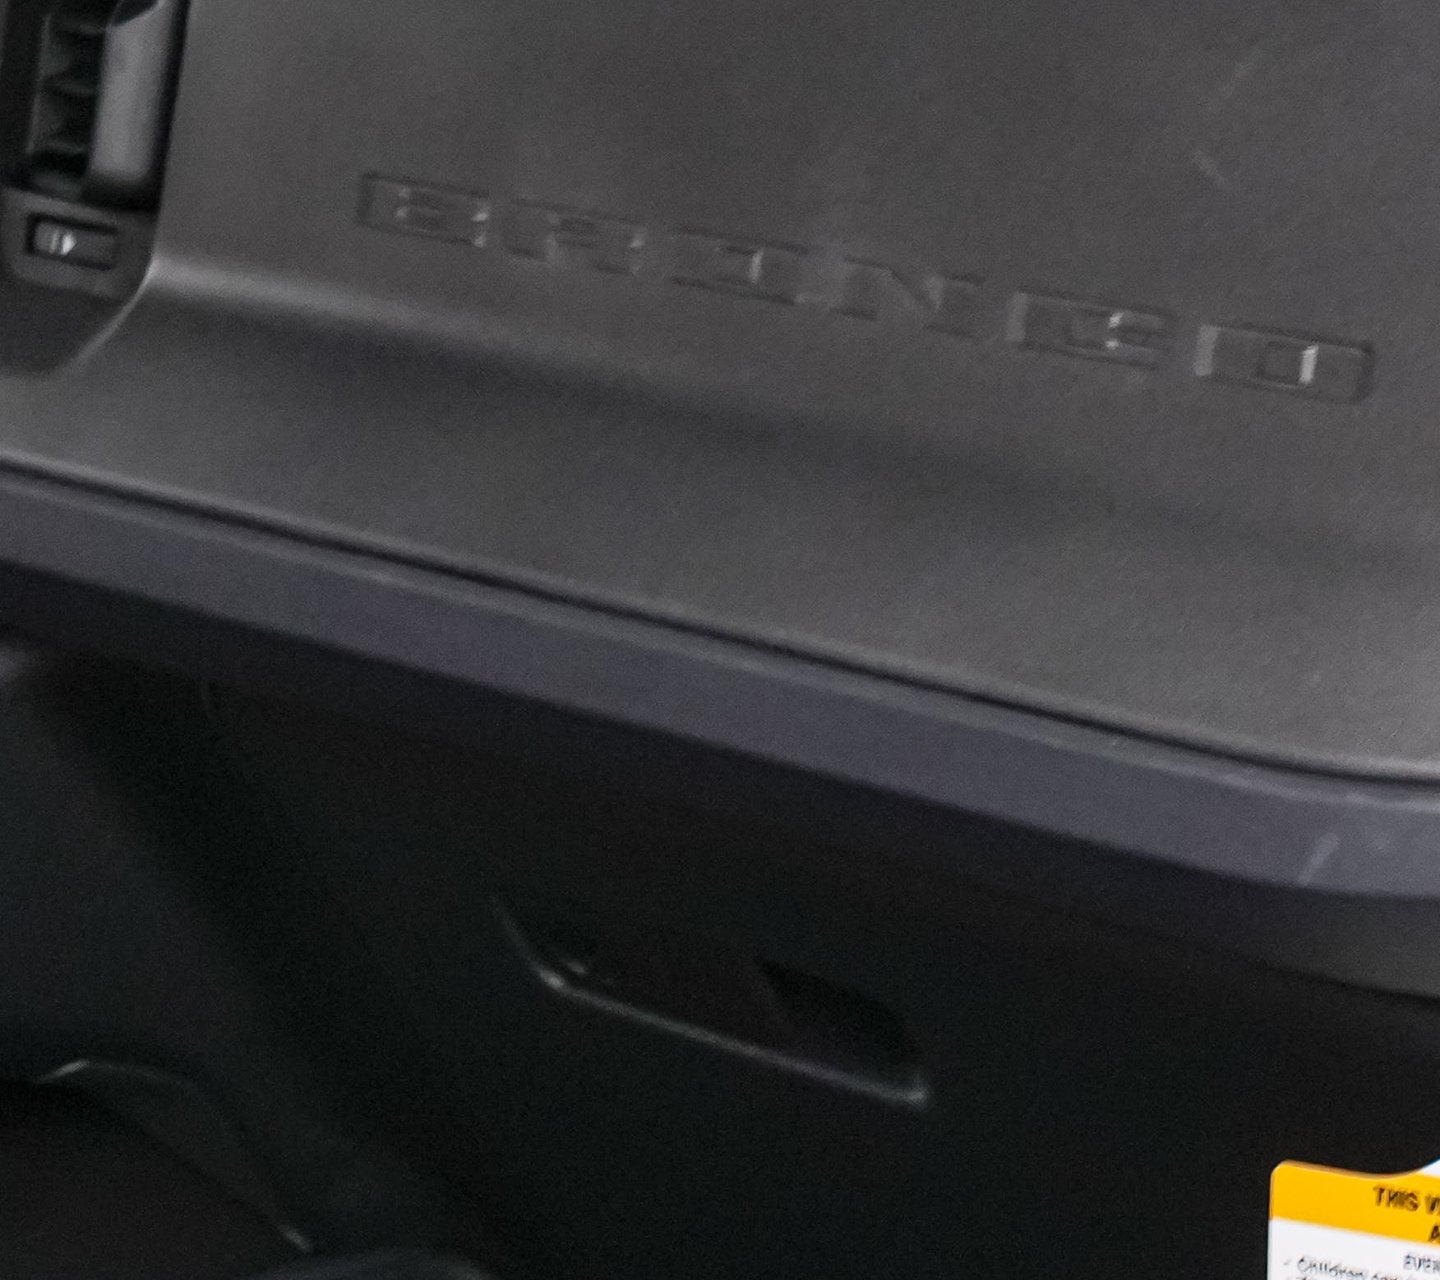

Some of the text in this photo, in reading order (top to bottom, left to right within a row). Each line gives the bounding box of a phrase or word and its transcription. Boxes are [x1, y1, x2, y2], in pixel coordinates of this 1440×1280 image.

[354, 169, 1377, 405] BRONCO
[1374, 1187, 1418, 1211] THIS
[1296, 1257, 1364, 1280] Children
